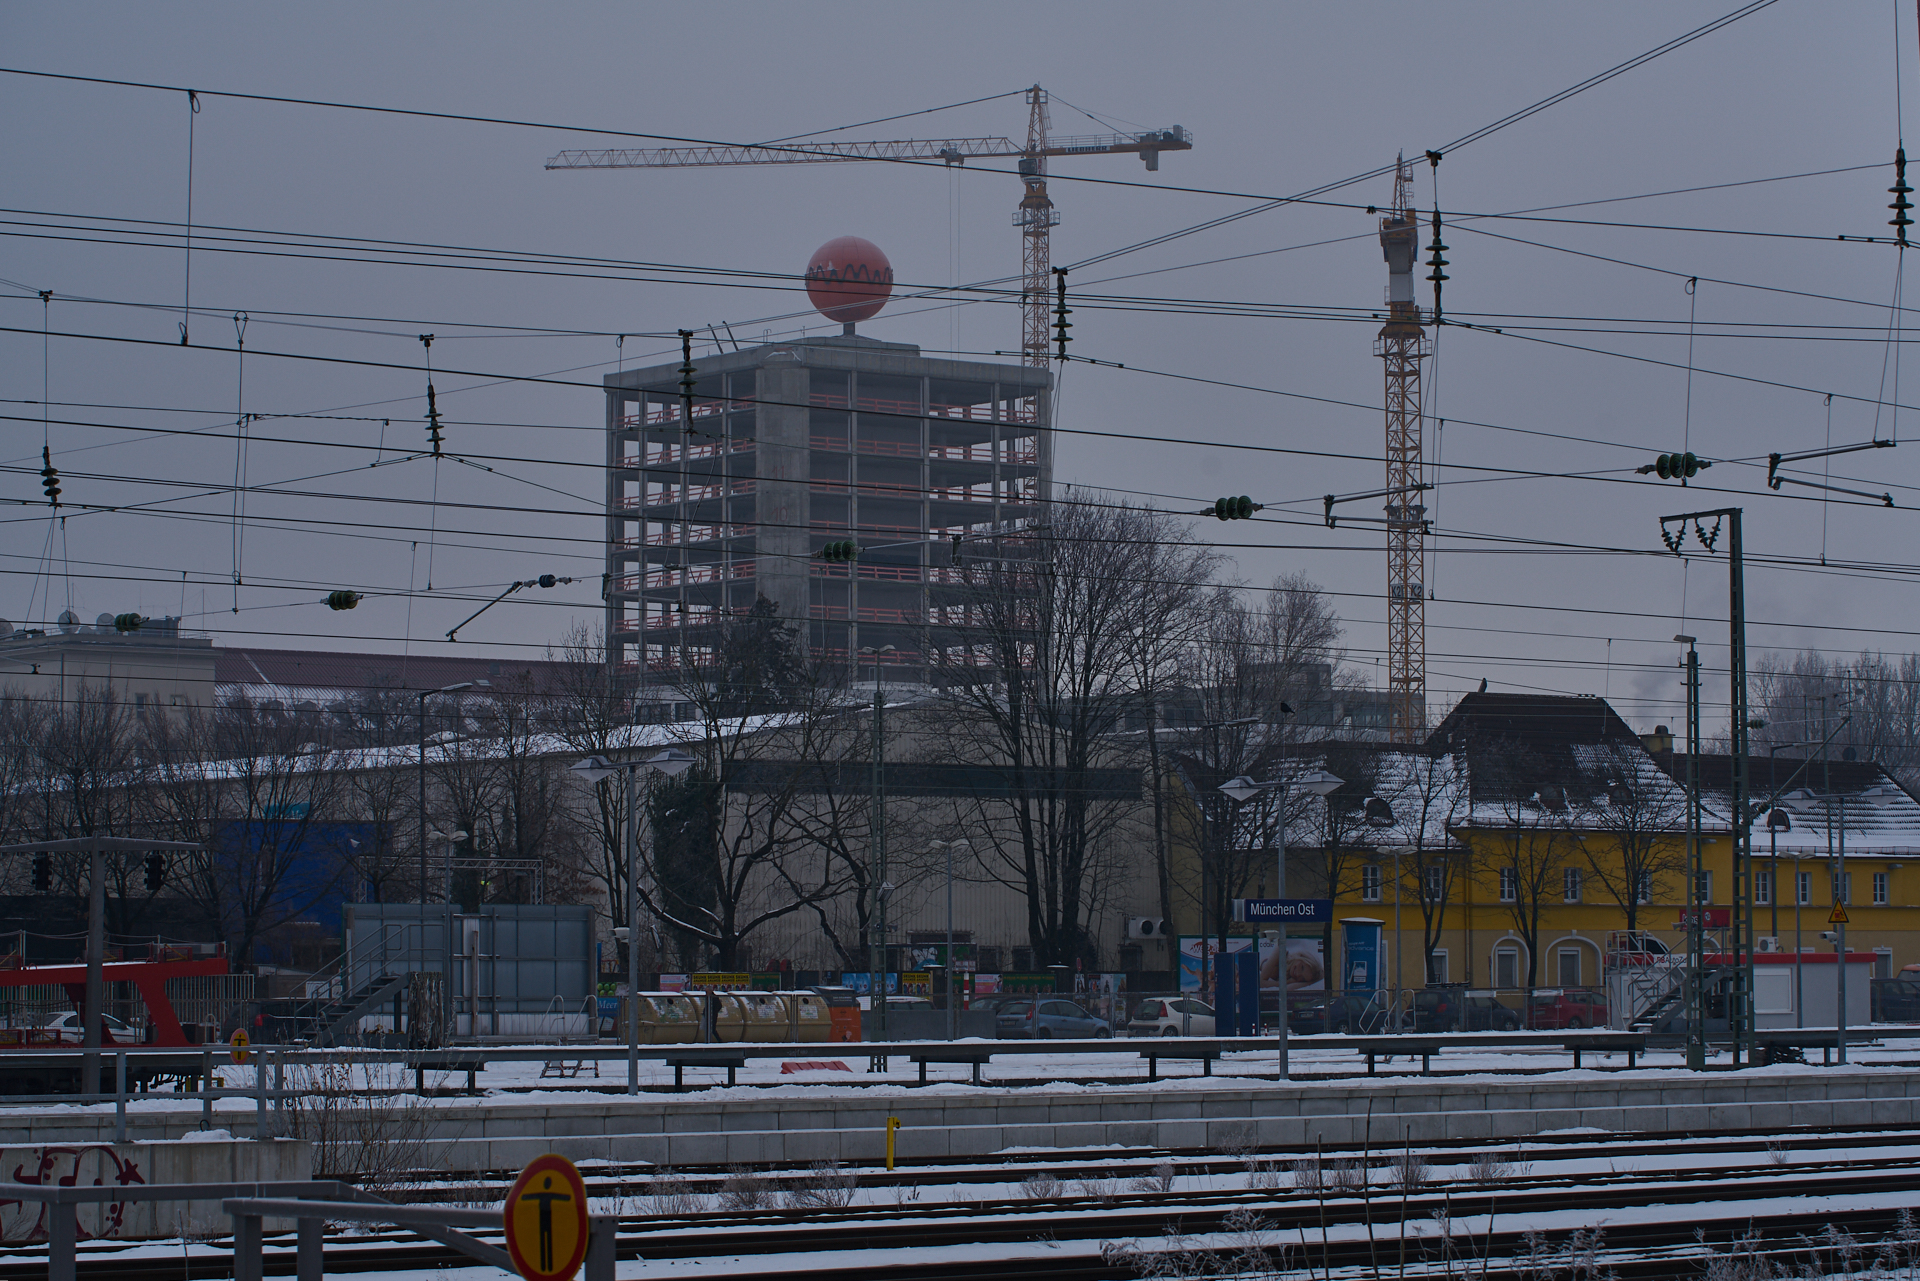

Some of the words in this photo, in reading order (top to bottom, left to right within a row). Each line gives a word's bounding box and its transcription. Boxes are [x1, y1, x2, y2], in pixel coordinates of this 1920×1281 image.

[771, 507, 788, 522] 10
[1250, 903, 1295, 916] München
[1298, 903, 1315, 916] Ost
[598, 1000, 618, 1009] Meer
